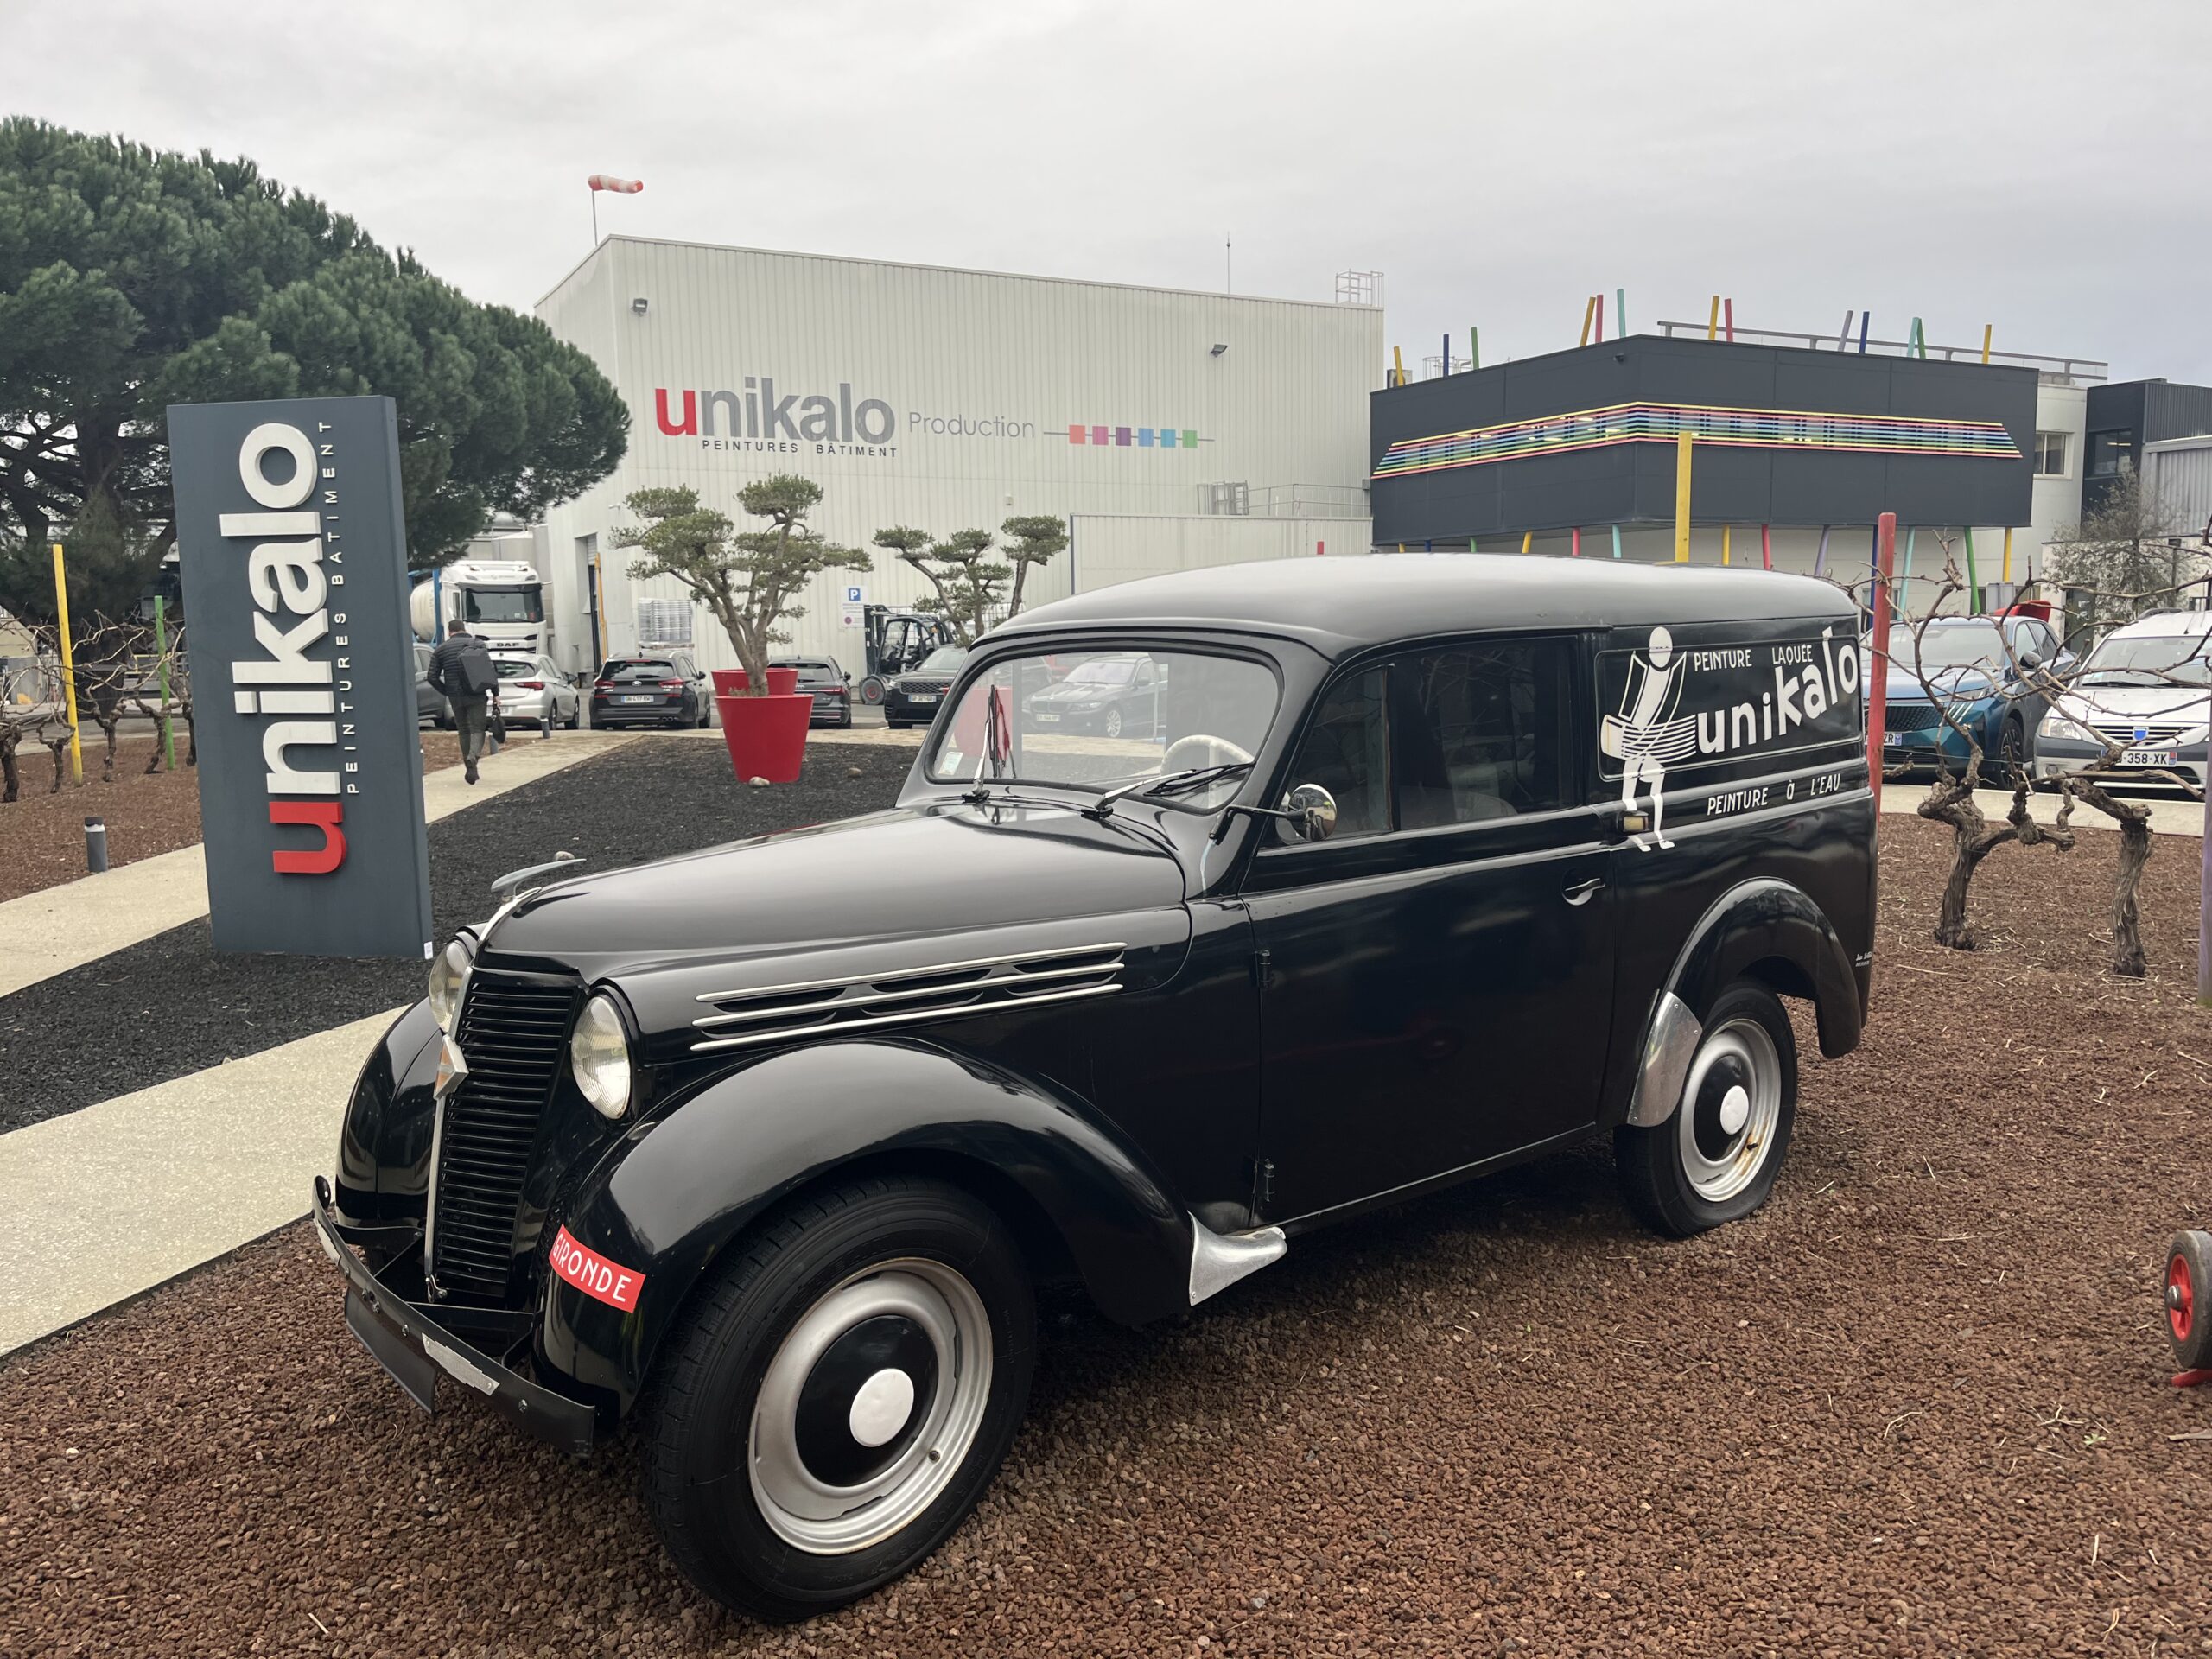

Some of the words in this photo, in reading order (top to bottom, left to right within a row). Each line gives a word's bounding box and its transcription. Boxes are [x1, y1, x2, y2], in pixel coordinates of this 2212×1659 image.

[655, 377, 896, 445] unikalo
[908, 411, 1035, 439] Production
[701, 439, 799, 454] PEINTURES
[816, 442, 897, 457] BÂTIMENT
[318, 422, 345, 586] BATIMENT
[850, 589, 859, 601] P
[219, 423, 346, 874] unikalo
[1694, 649, 1752, 671] PEINTURE
[334, 612, 359, 795] PEINTURES
[1697, 626, 1858, 754] unikalo
[1707, 787, 1769, 816] PEINTURE
[1810, 773, 1840, 796] L'EAU
[552, 1233, 632, 1302] GIRONDE
